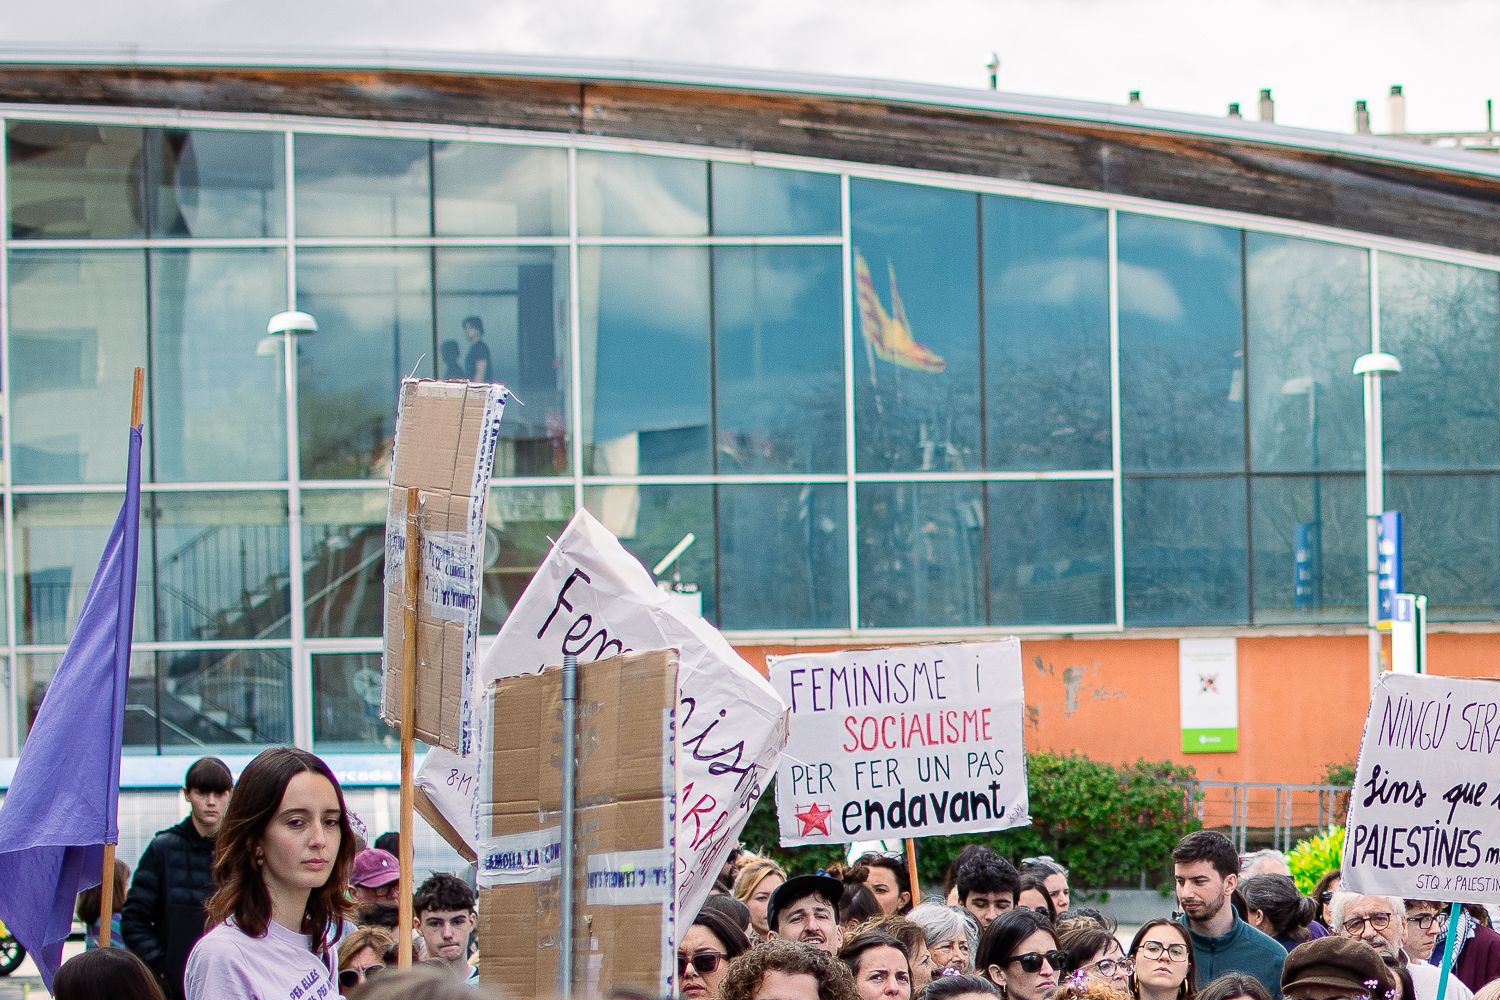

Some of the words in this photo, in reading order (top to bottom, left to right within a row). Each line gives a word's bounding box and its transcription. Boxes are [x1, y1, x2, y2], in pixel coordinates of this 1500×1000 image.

[1378, 691, 1452, 751] NINGÚ
[791, 762, 836, 796] PER
[855, 757, 901, 791] FER
[917, 754, 950, 783] UN
[966, 749, 1005, 778] PAS
[841, 779, 1006, 836] endavant
[1442, 779, 1488, 825] que
[1416, 873, 1441, 891] STQ
